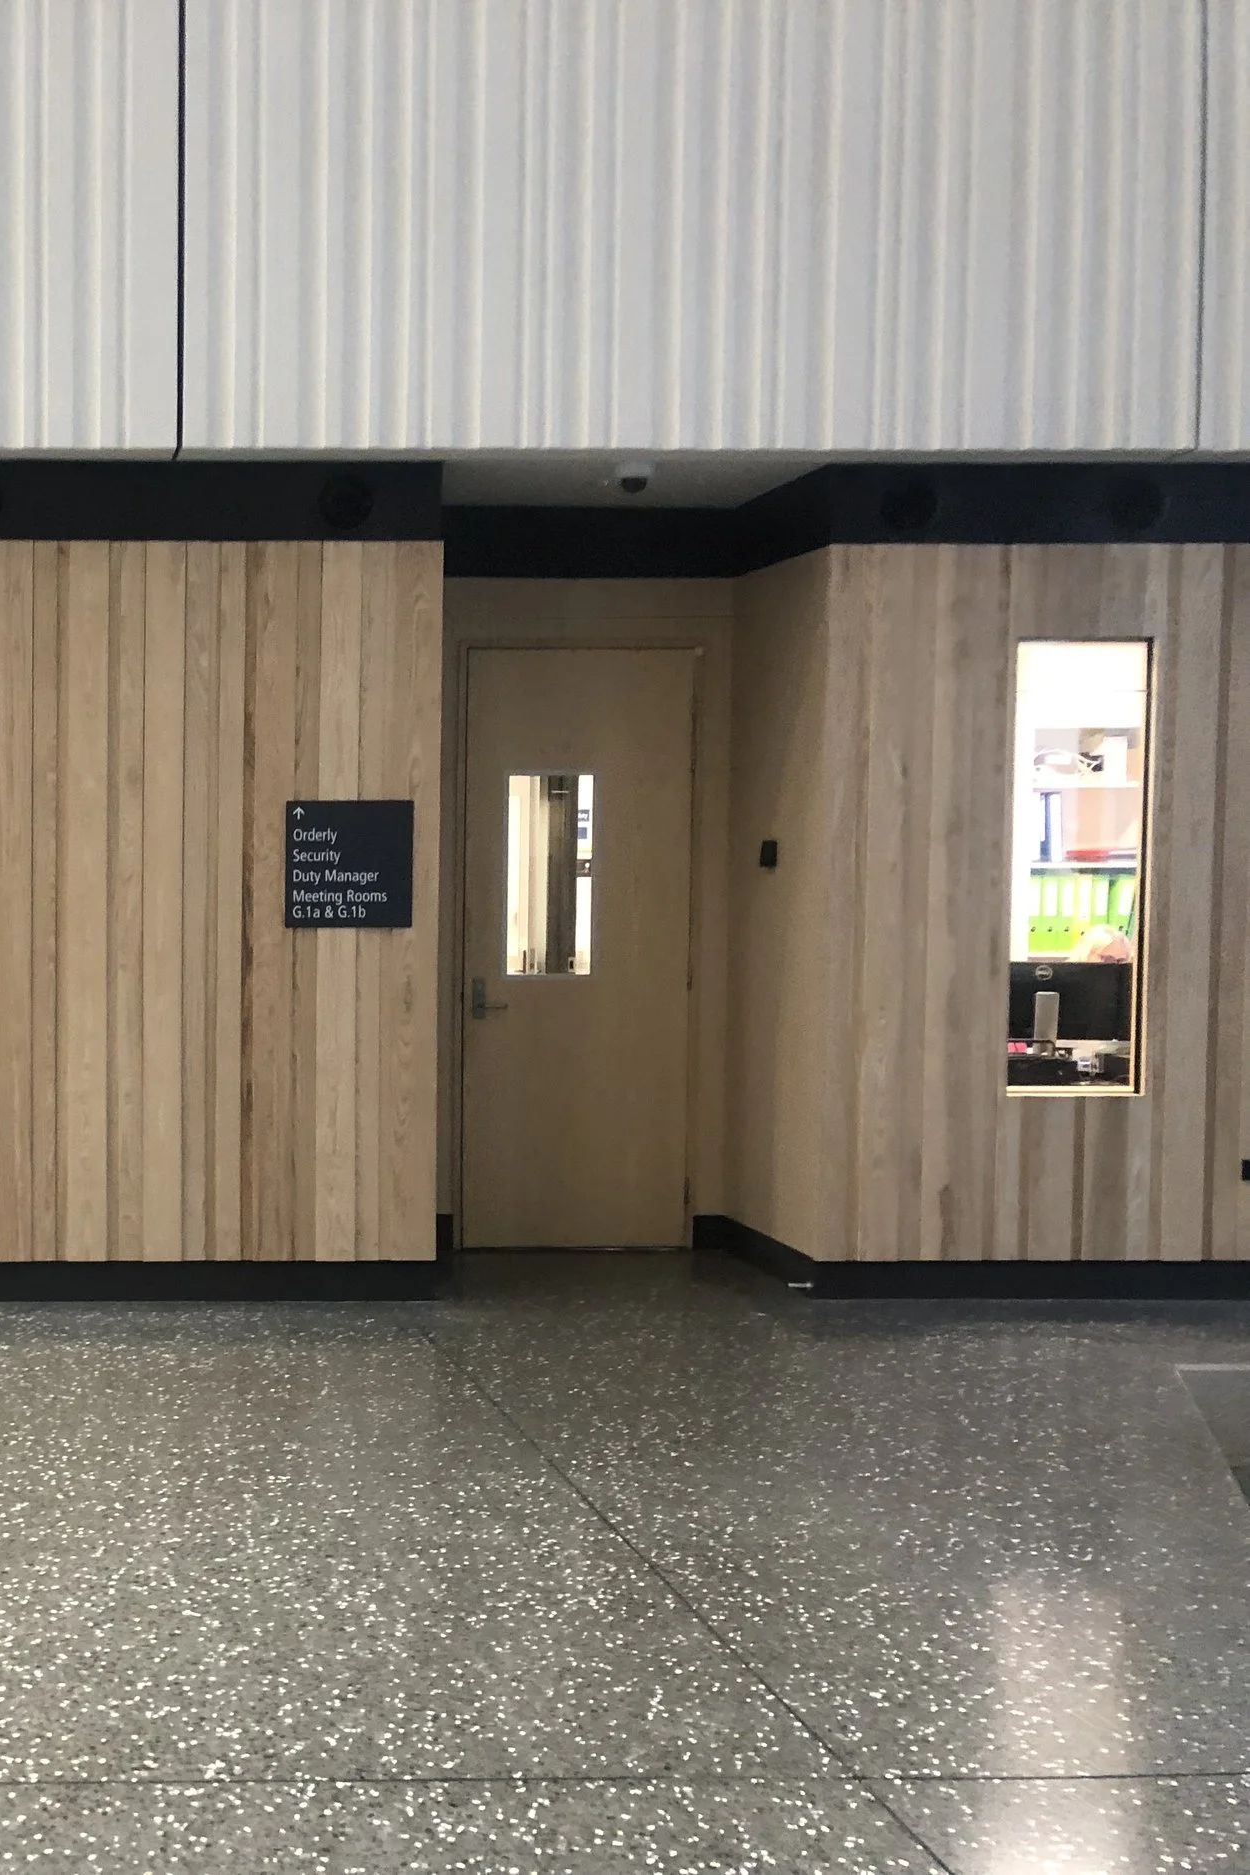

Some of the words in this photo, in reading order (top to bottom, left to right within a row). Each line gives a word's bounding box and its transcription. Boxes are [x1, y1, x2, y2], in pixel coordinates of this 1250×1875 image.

[293, 828, 338, 845] Orderly
[293, 849, 341, 865] Security
[293, 869, 321, 885] Duty
[325, 869, 379, 885] Manager
[293, 889, 343, 905] Meeting
[347, 889, 388, 902] Rooms
[292, 905, 321, 918] G.1a
[325, 905, 334, 918] &
[338, 905, 366, 918] G.1b
